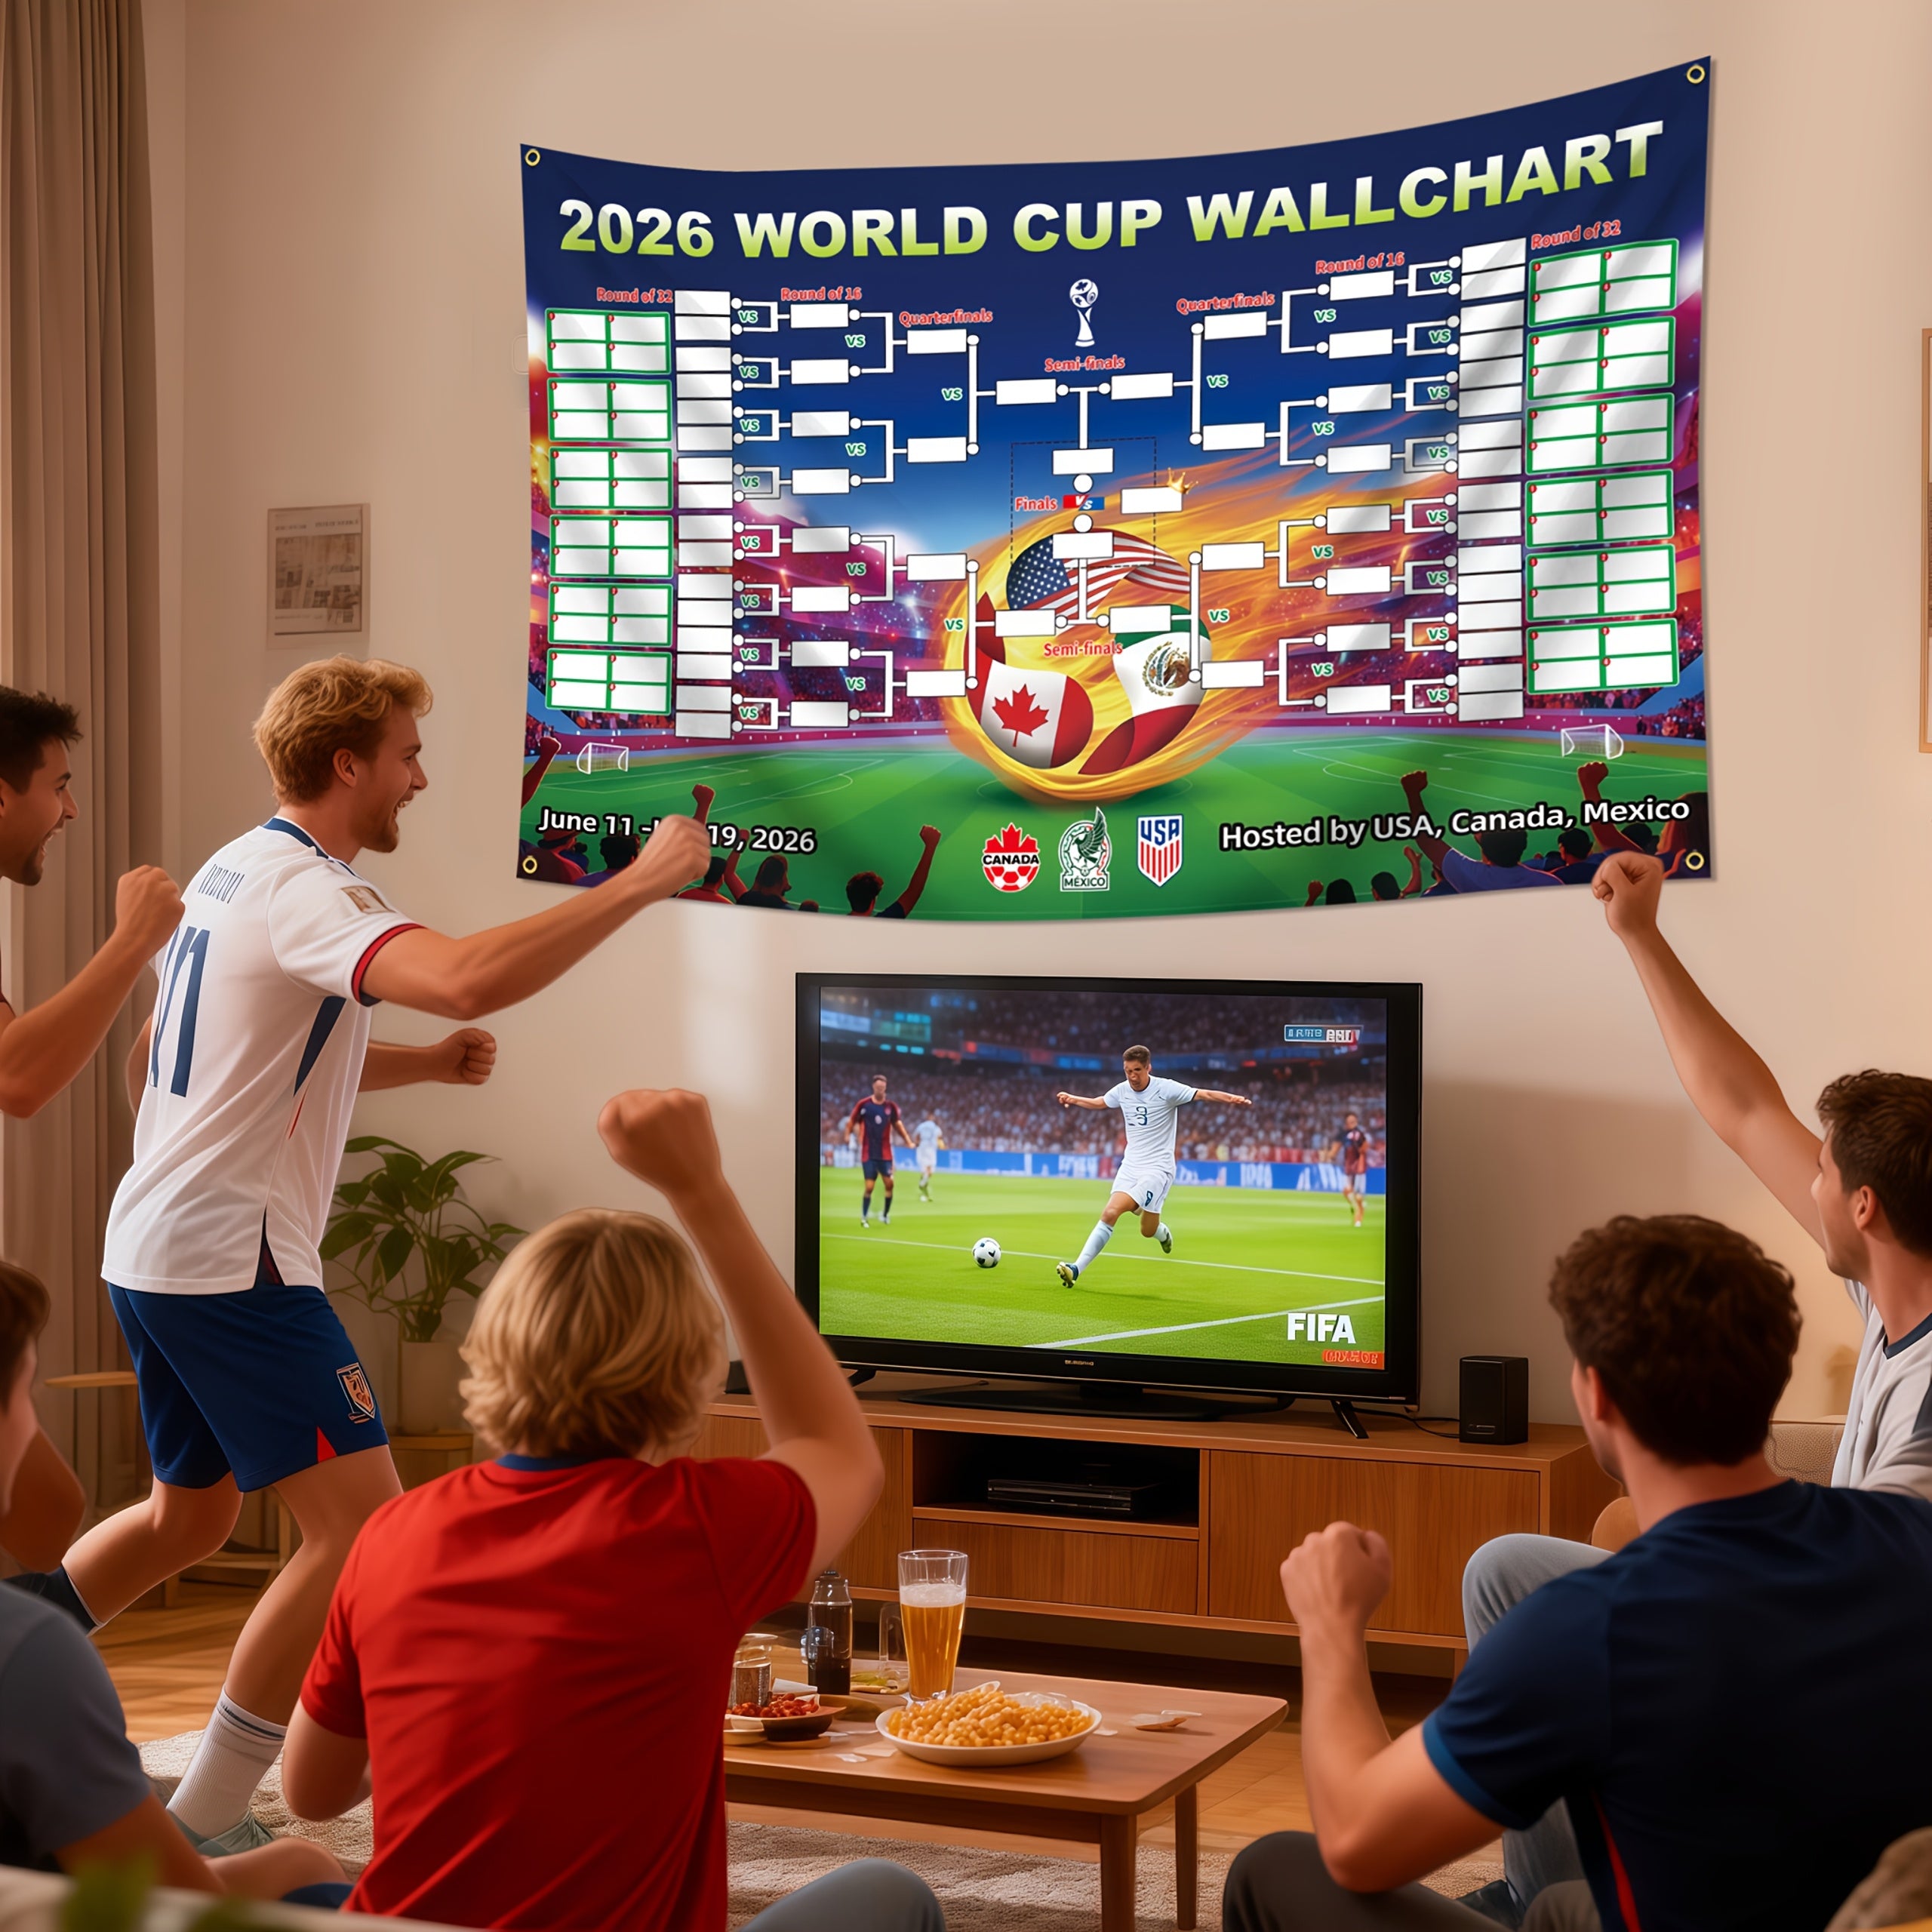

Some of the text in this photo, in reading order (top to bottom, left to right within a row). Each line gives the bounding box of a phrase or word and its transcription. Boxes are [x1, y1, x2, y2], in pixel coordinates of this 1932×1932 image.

[559, 121, 1663, 257] 2026 WORLD CUP WALLCHART
[1531, 220, 1621, 250] Round of 32
[1315, 251, 1405, 274] Round of 16
[597, 287, 673, 303] Round of 32
[781, 286, 862, 301] Round of 16
[1177, 291, 1275, 315] Quarterfinals
[899, 308, 993, 328] Quarterfinals
[1044, 354, 1125, 372] Semi-finals
[1015, 496, 1057, 511] Finals
[1044, 639, 1123, 657] Semi-finals
[537, 808, 598, 832] June
[605, 815, 631, 835] 11
[708, 825, 744, 851] 19,
[752, 828, 815, 852] 2026
[1140, 818, 1180, 846] USA
[1223, 798, 1690, 848] Hosted by USA, Canada, Mexico
[983, 854, 1039, 866] CANADA
[1287, 1312, 1357, 1343] FIFA
